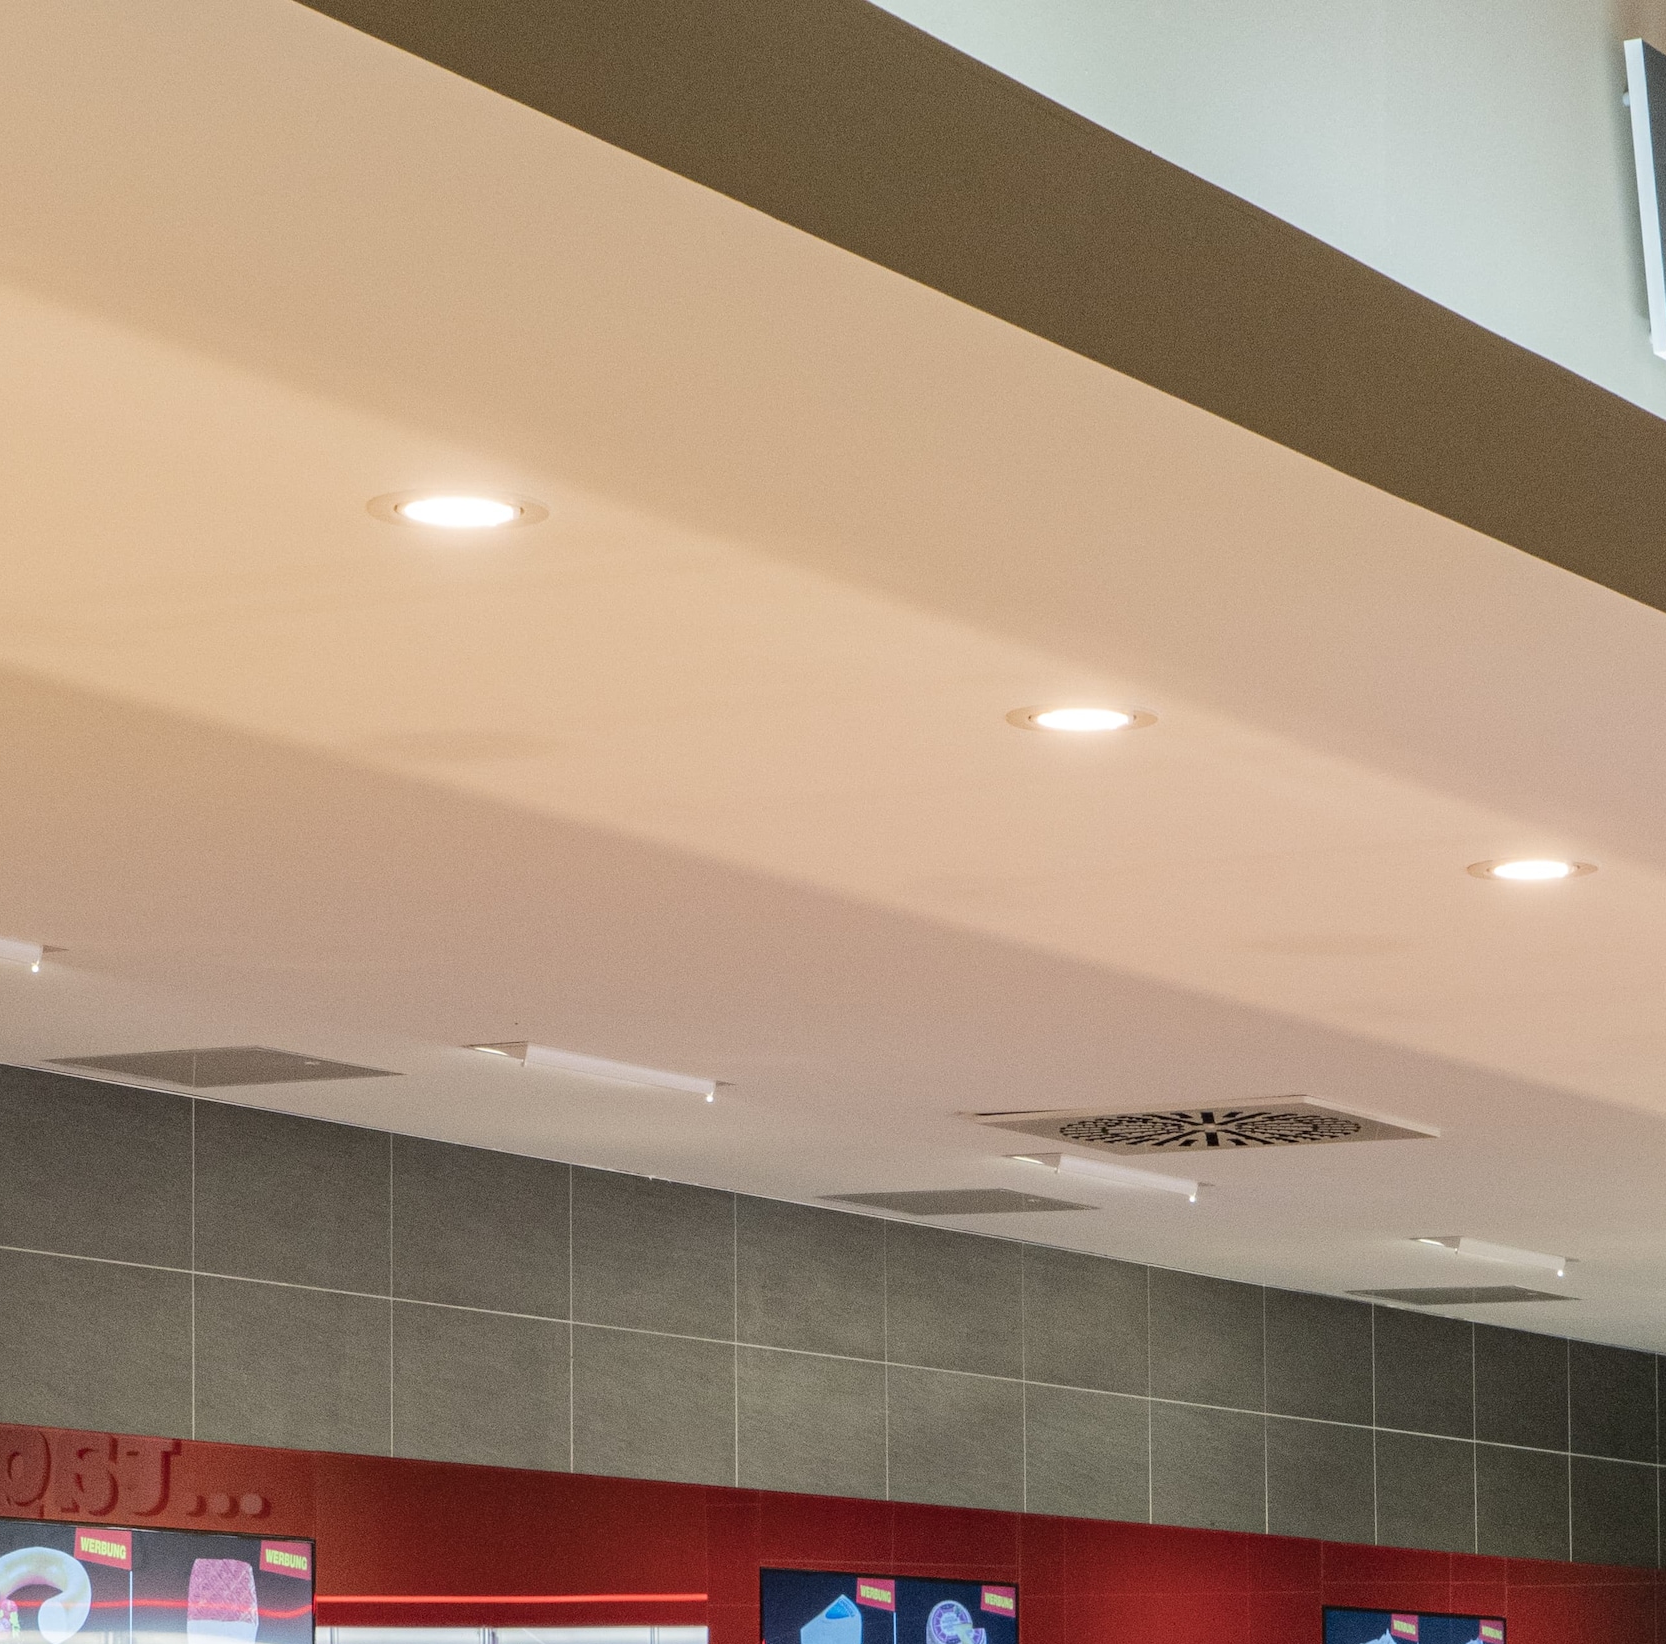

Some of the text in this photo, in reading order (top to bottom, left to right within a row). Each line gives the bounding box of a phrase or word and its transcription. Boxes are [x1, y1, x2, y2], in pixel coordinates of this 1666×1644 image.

[80, 1536, 127, 1560] WERBUNG
[266, 1549, 307, 1571] WERBUNG
[860, 1585, 891, 1604] WERBUNG
